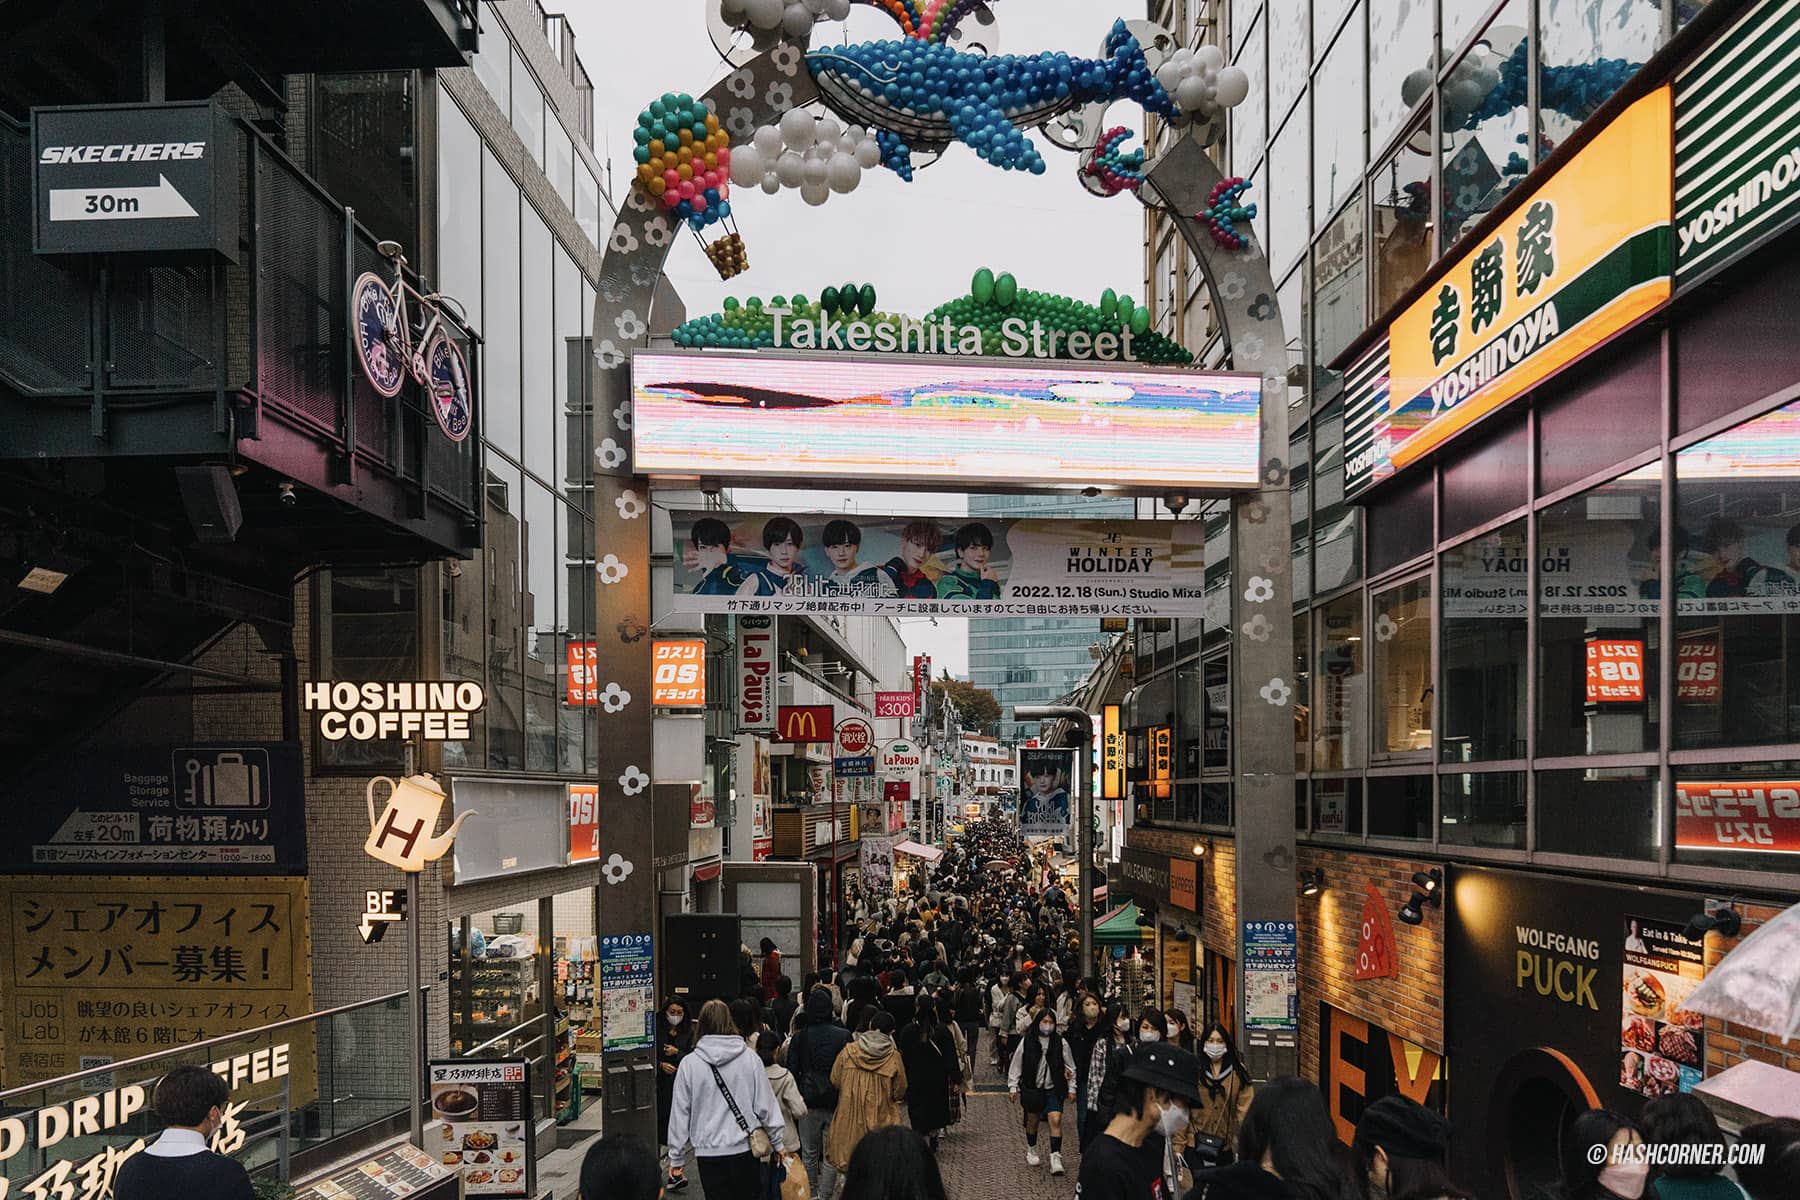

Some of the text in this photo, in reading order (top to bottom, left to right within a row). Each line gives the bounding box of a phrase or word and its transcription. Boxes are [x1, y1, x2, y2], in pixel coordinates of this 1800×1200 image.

[40, 142, 206, 164] SKECHERS
[85, 195, 139, 213] 30m
[763, 307, 1137, 362] Takeshita Street
[1430, 300, 1560, 417] YOSHINOYA
[1070, 547, 1153, 557] WINTER
[1067, 558, 1154, 573] HOLIDAY
[1012, 585, 1092, 599] 2022.12.18
[1129, 588, 1170, 600] Studio
[1172, 588, 1202, 599] Mixa
[656, 646, 697, 660] クスリ
[655, 664, 699, 684] OS
[741, 634, 771, 723] La Pausa
[1678, 662, 1718, 681] OS
[304, 682, 484, 711] HOSHINO
[655, 688, 700, 700] ドラッグ
[320, 711, 470, 740] COFFEE
[884, 754, 920, 766] La Pausa
[124, 773, 169, 786] Baggage
[129, 785, 169, 797] Storage
[131, 797, 170, 808] Service
[148, 815, 270, 842] 荷物預かり
[366, 890, 394, 913] BF
[22, 900, 281, 937] シェアオフィス
[1516, 925, 1600, 961] WOLFGANG
[26, 944, 271, 983] メンバー募集！
[1516, 950, 1600, 1011] PUCK
[22, 1000, 58, 1018] Job
[78, 1001, 291, 1019] 眺望の良いシェアオフィス
[22, 1022, 60, 1041] Lab
[19, 1052, 65, 1068] 原宿店
[38, 1085, 145, 1149] DRIP
